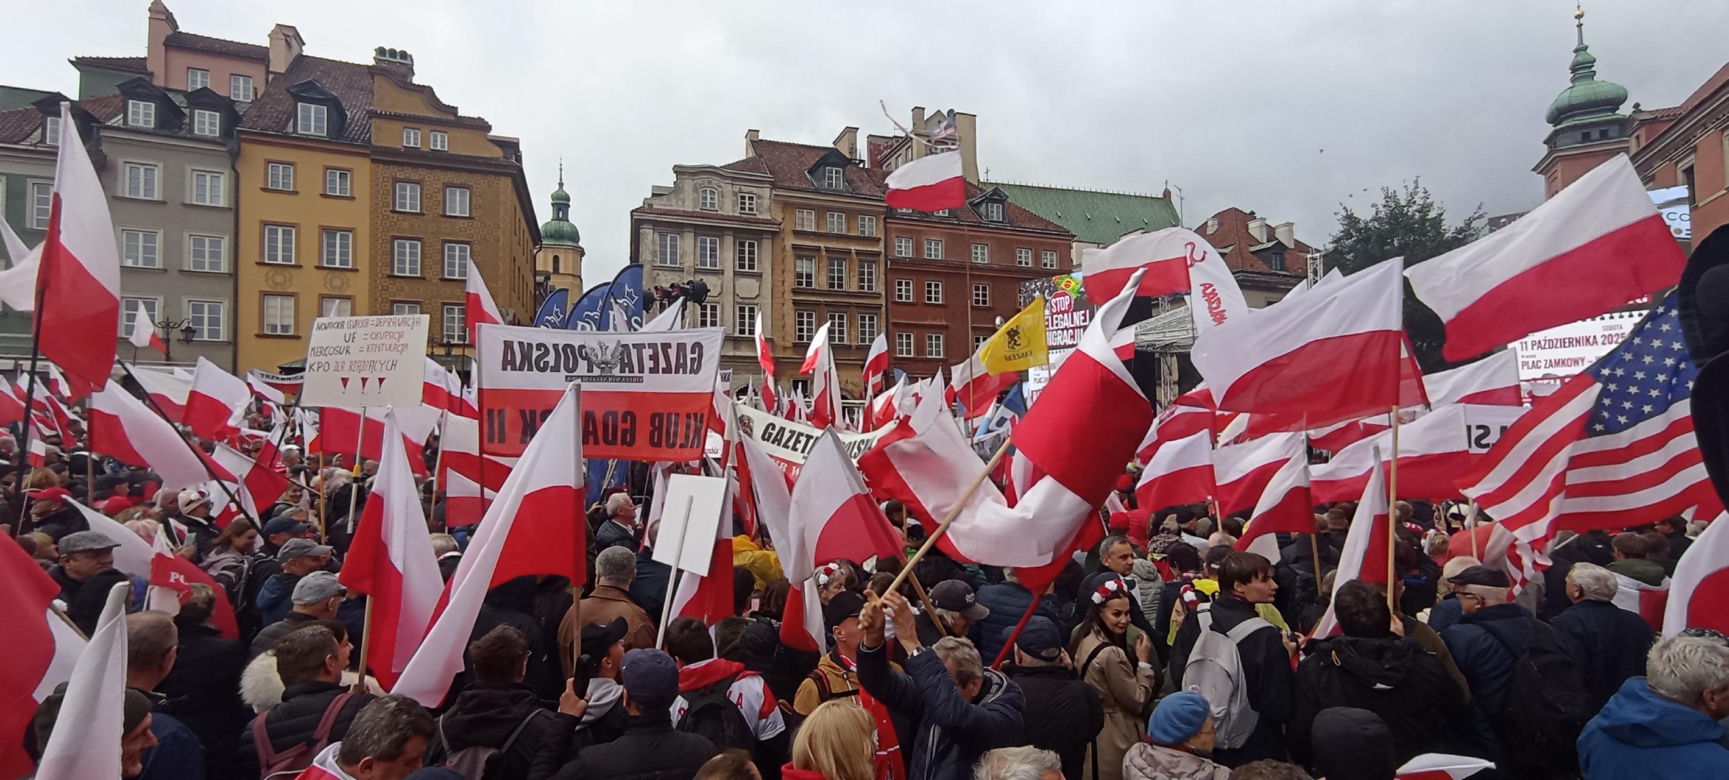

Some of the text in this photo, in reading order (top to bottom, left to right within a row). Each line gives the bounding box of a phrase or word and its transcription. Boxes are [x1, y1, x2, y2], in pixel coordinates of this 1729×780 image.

[1051, 295, 1070, 313] STOP
[343, 332, 357, 343] UE
[1520, 341, 1528, 351] 11
[1531, 335, 1598, 351] PAŹDZIERNIKA
[310, 345, 351, 357] MERCOSUR
[309, 361, 330, 372] KPO
[1521, 360, 1541, 370] PLAC
[1544, 357, 1585, 369] ZAMKOWY
